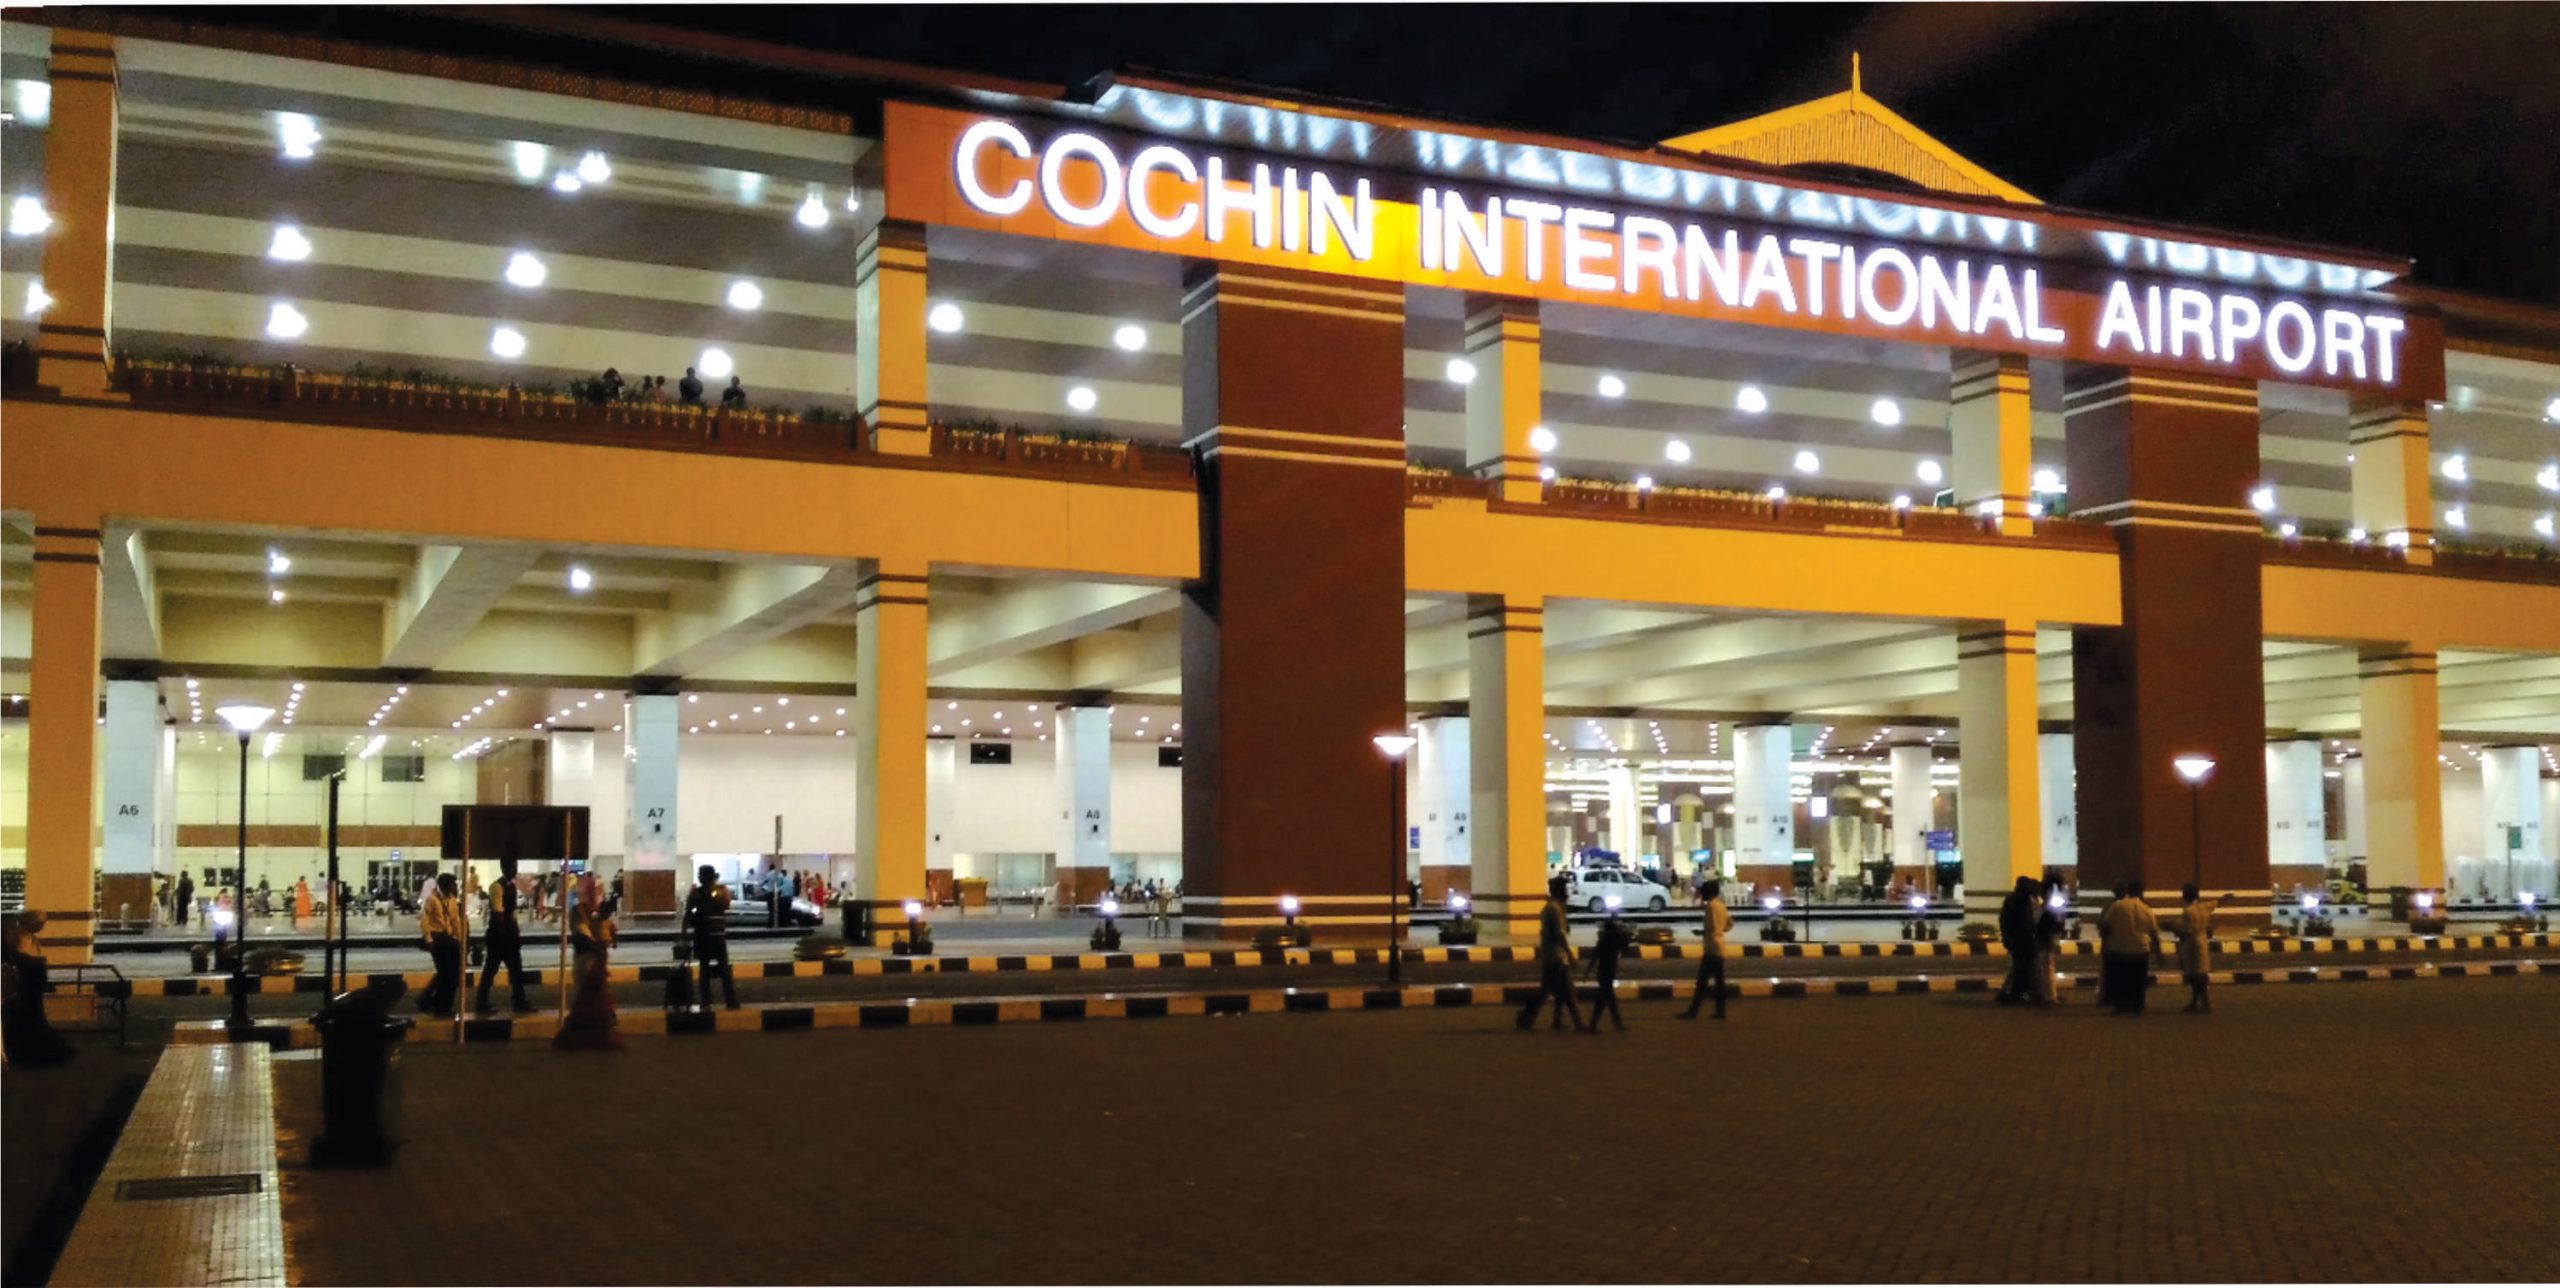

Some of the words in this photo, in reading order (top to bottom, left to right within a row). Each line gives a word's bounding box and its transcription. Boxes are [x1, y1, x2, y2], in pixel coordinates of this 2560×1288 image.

[953, 119, 1373, 263] COCHIN
[1420, 185, 2066, 343] INTERNATIONAL
[2095, 281, 2406, 383] AIRPORT
[118, 804, 139, 816] A6
[647, 808, 666, 818] A7
